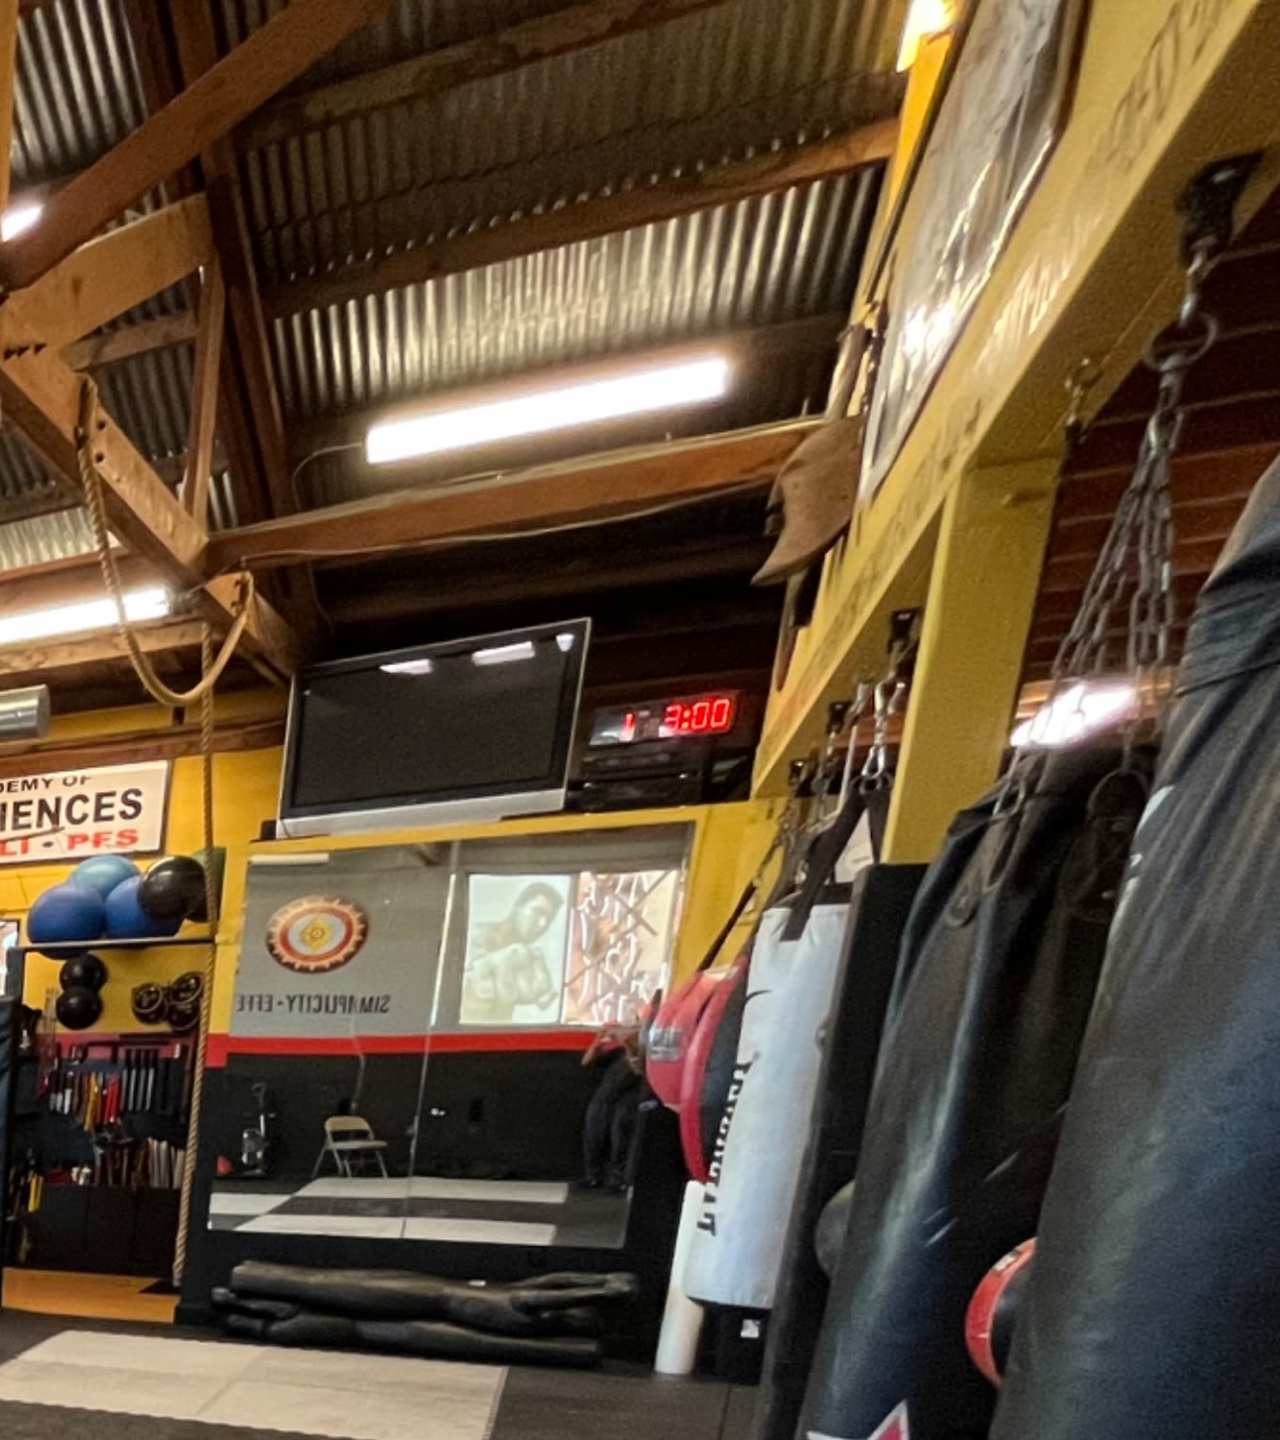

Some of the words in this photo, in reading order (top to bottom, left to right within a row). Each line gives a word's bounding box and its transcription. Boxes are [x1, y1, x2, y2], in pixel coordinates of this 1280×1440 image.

[664, 698, 730, 734] 3:00
[62, 775, 91, 789] OF
[66, 828, 140, 850] PFS
